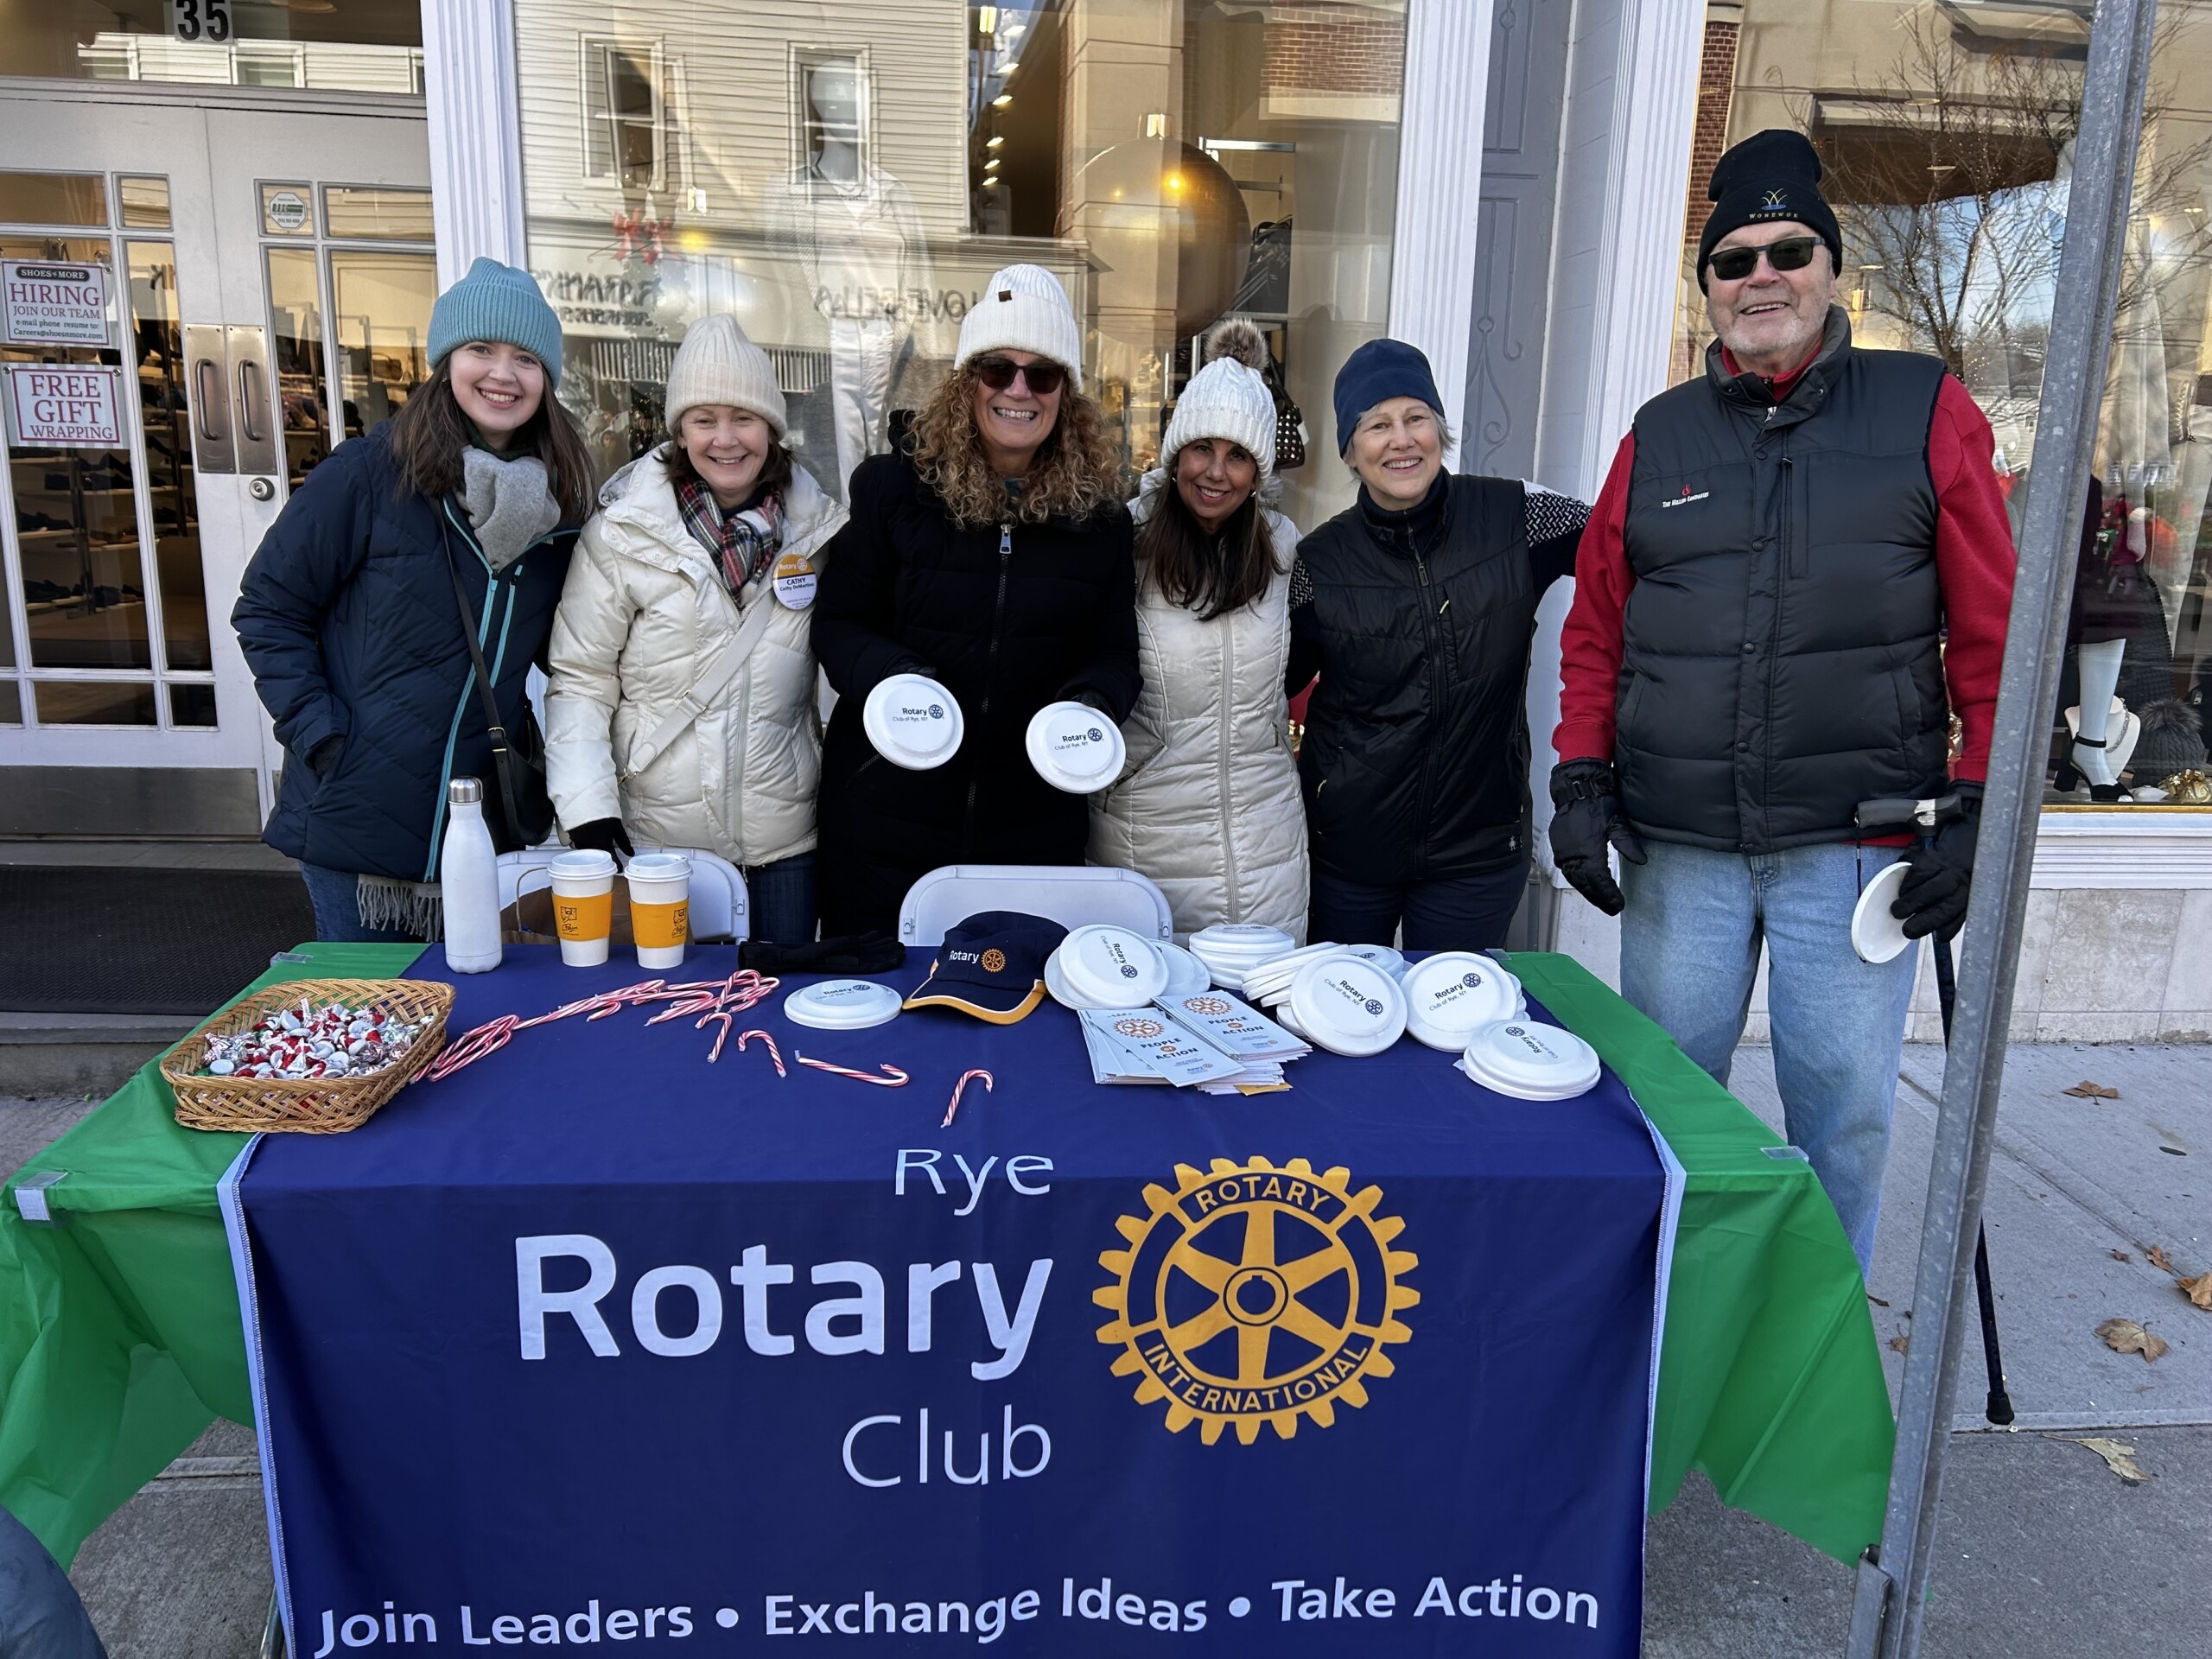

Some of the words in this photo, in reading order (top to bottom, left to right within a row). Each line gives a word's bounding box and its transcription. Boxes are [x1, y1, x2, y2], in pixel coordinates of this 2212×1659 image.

[176, 0, 229, 42] 35
[21, 269, 52, 277] SHOES
[10, 283, 100, 306] HIRING
[13, 305, 39, 316] JOIN
[41, 306, 67, 318] OUR
[67, 308, 100, 319] TEAM
[16, 318, 38, 327] e-mail
[40, 320, 60, 328] phone
[90, 321, 99, 329] to:
[13, 327, 104, 340] Careers@shoesnmore.com
[29, 374, 101, 398] FREE
[34, 399, 102, 424] GIFT
[30, 424, 113, 439] WRAPPING
[1062, 734, 1087, 742] Rotary
[949, 950, 980, 964] Rotary
[1112, 943, 1128, 964] Rotary
[1325, 978, 1336, 988] Club
[1339, 980, 1366, 1002] Rotary
[1434, 982, 1463, 1000] Rotary
[1428, 1002, 1442, 1011] Club
[1208, 1016, 1249, 1025] PEOPLE
[1222, 1026, 1264, 1034] ACTION
[1141, 1038, 1182, 1048] PEOPLE
[1521, 1037, 1542, 1053] Rotary
[1155, 1047, 1198, 1059] ACTION
[895, 1148, 1054, 1217] Rye
[1194, 1175, 1331, 1213] ROTARY
[515, 1234, 1054, 1381] Rotary
[1143, 1343, 1369, 1413] INTERNATIONAL
[842, 1404, 1052, 1488] Club
[315, 1600, 437, 1659] Join
[461, 1599, 694, 1645] Leaders
[766, 1589, 1040, 1644] Exchange
[1062, 1576, 1208, 1632] Ideas
[1271, 1578, 1396, 1623] Take
[1413, 1573, 1599, 1629] Action
